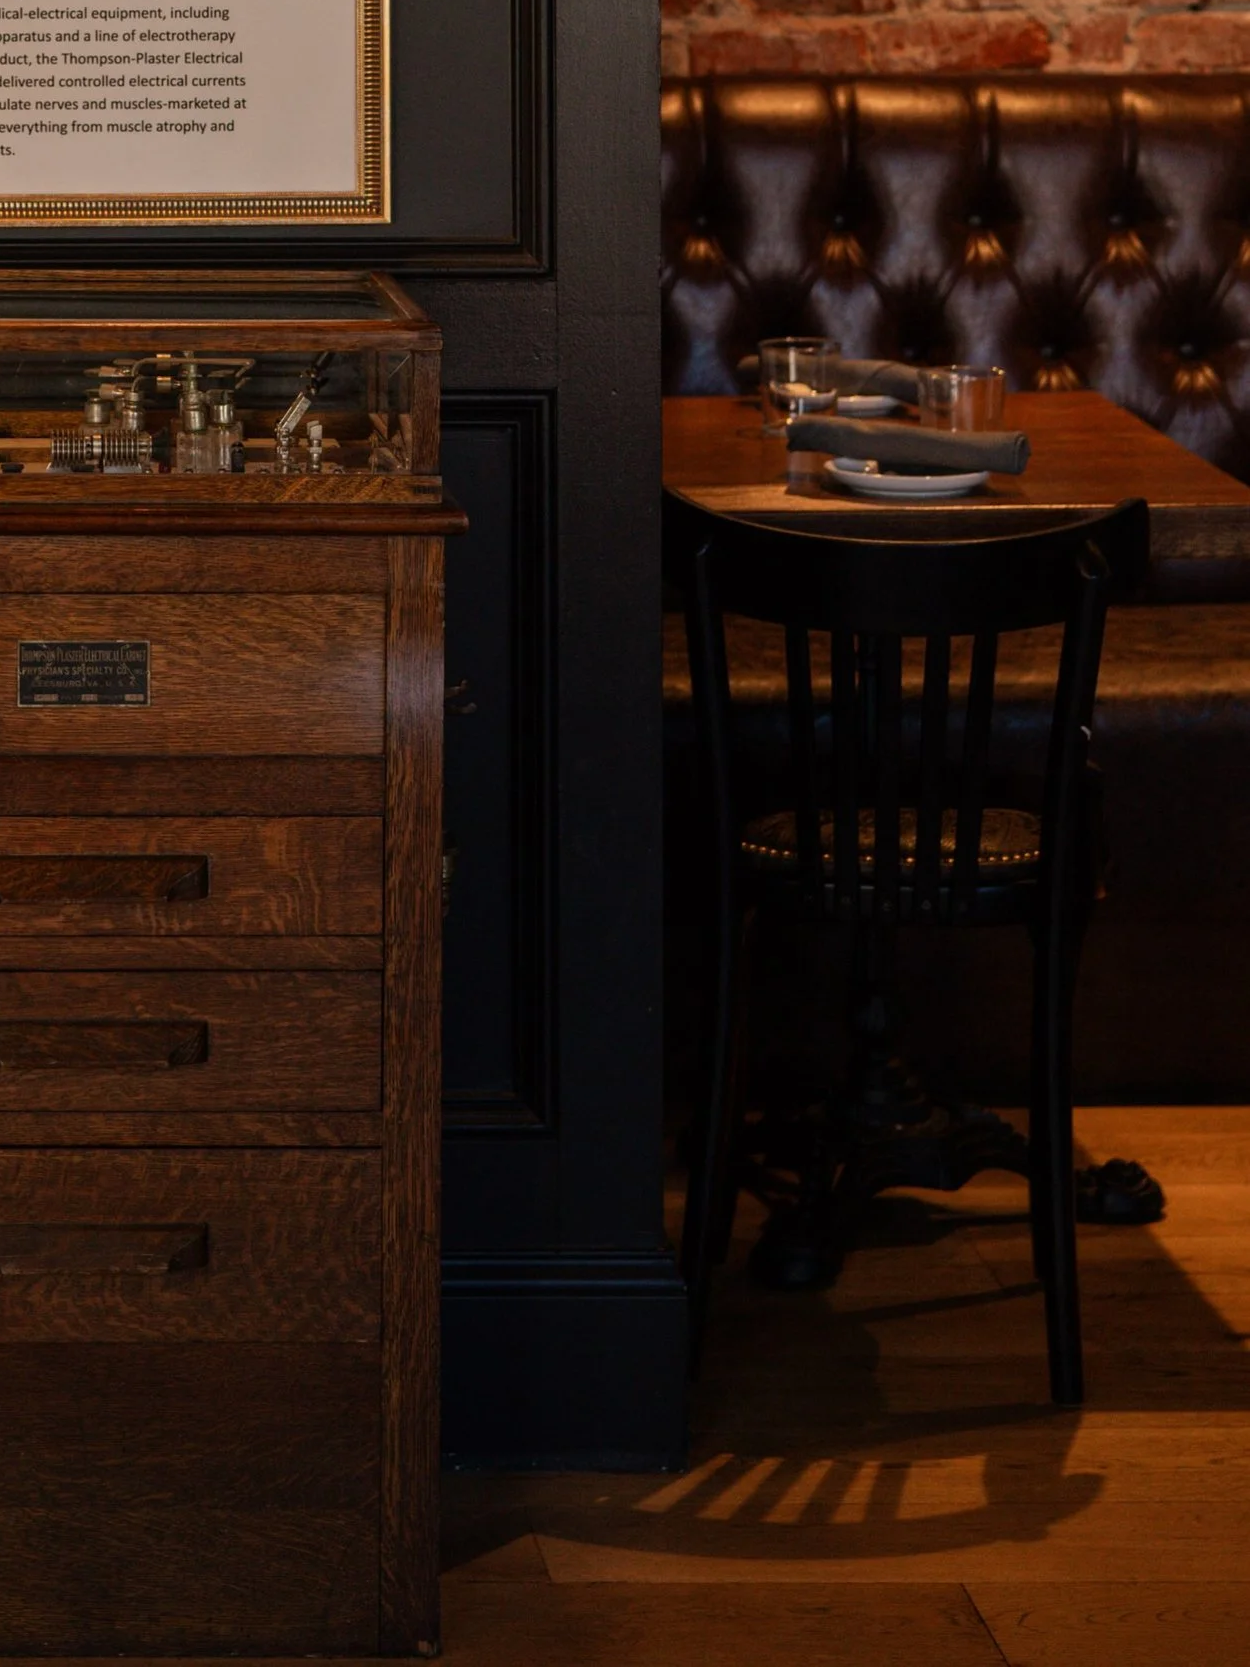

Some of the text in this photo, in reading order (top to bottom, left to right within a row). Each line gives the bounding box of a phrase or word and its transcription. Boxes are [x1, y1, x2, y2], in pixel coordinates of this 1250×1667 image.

[90, 6, 167, 22] equipment,
[170, 5, 231, 22] including
[54, 29, 80, 43] and
[82, 32, 92, 43] a
[94, 29, 120, 43] line
[121, 28, 137, 43] of
[138, 28, 236, 45] electrotherapy
[35, 52, 59, 66] the
[60, 51, 182, 68] Thompson-Plaster
[183, 51, 243, 65] Electrical
[58, 74, 126, 88] controlled
[128, 73, 189, 88] electrical
[191, 75, 247, 87] currents
[34, 100, 79, 111] nerves
[81, 97, 107, 111] and
[110, 96, 231, 111] muscles-marketed
[233, 97, 247, 110] at
[70, 119, 103, 133] from
[106, 119, 154, 133] muscle
[155, 119, 208, 135] atrophy
[209, 119, 235, 133] and
